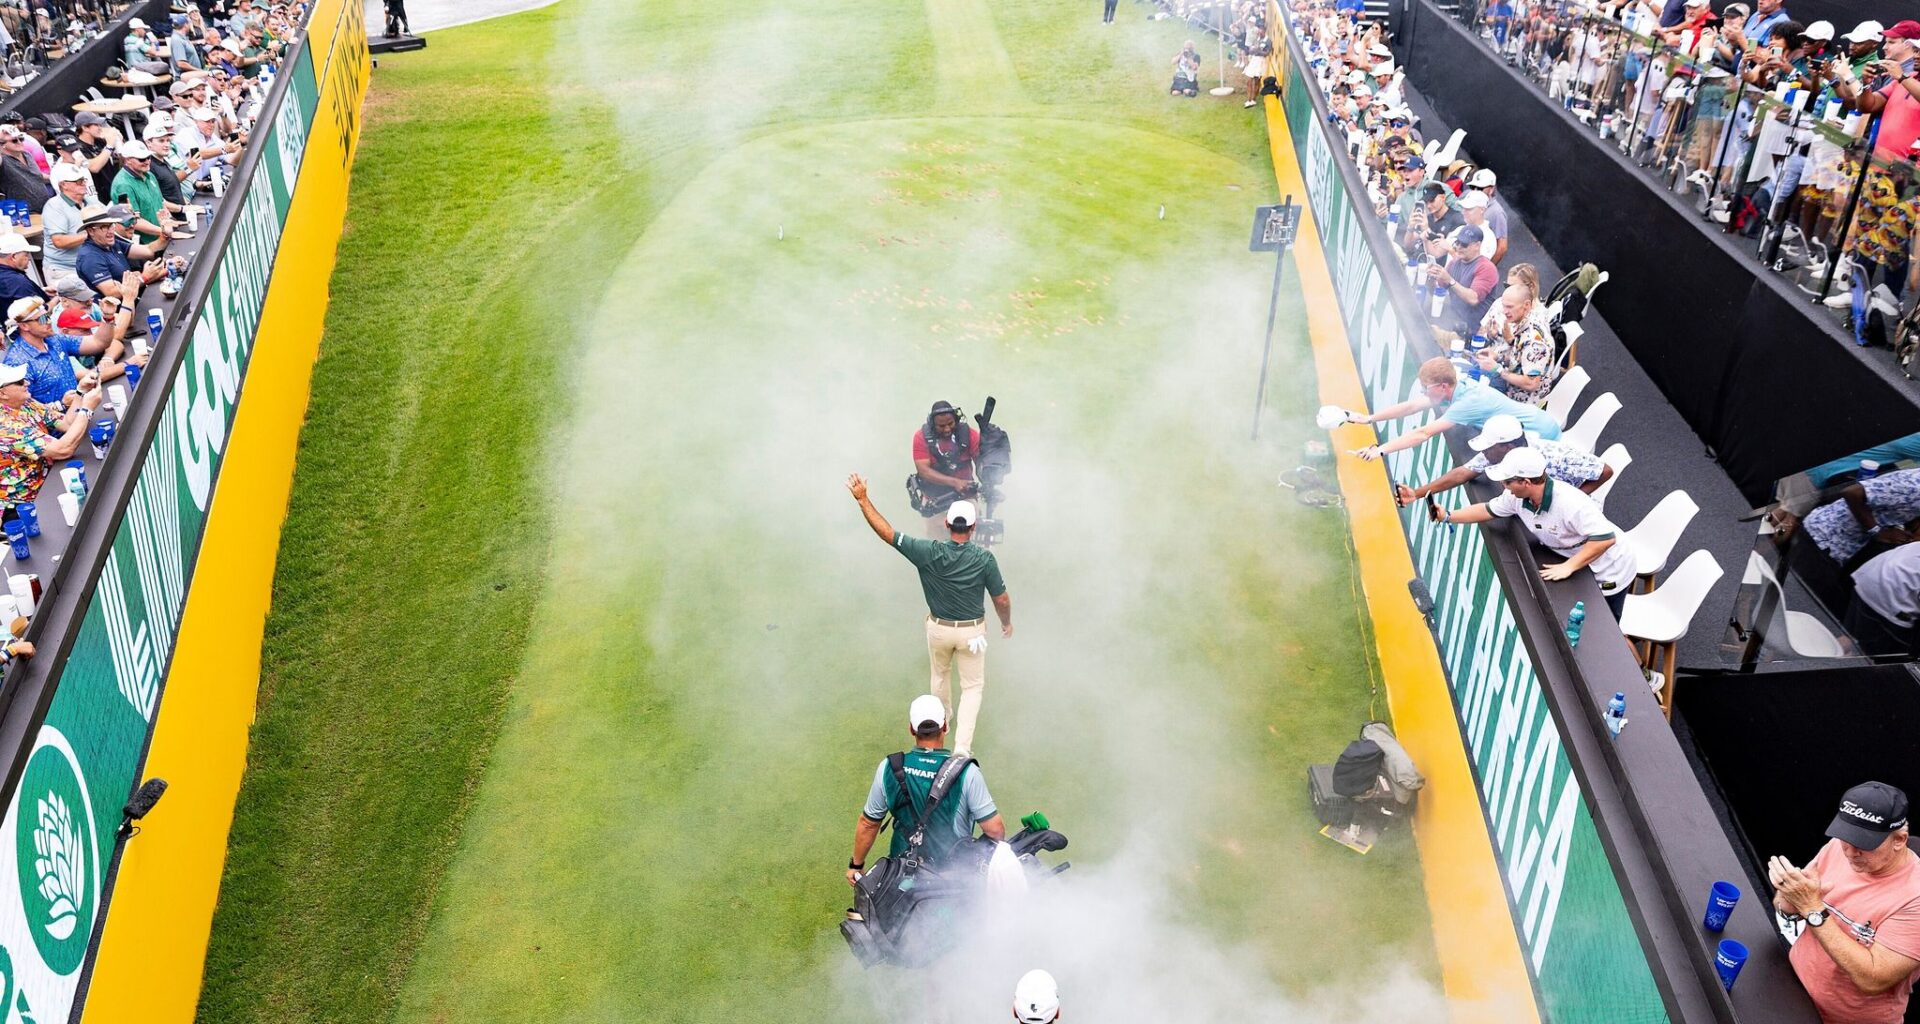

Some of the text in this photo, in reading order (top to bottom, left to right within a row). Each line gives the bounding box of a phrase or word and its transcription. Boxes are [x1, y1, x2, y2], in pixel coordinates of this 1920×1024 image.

[98, 388, 184, 723] LIV
[171, 254, 241, 512] GOLF
[1336, 186, 1582, 976] LIV GOLF SOUTH AFRICA
[903, 766, 937, 779] HWAR
[1839, 801, 1884, 824] Titleist
